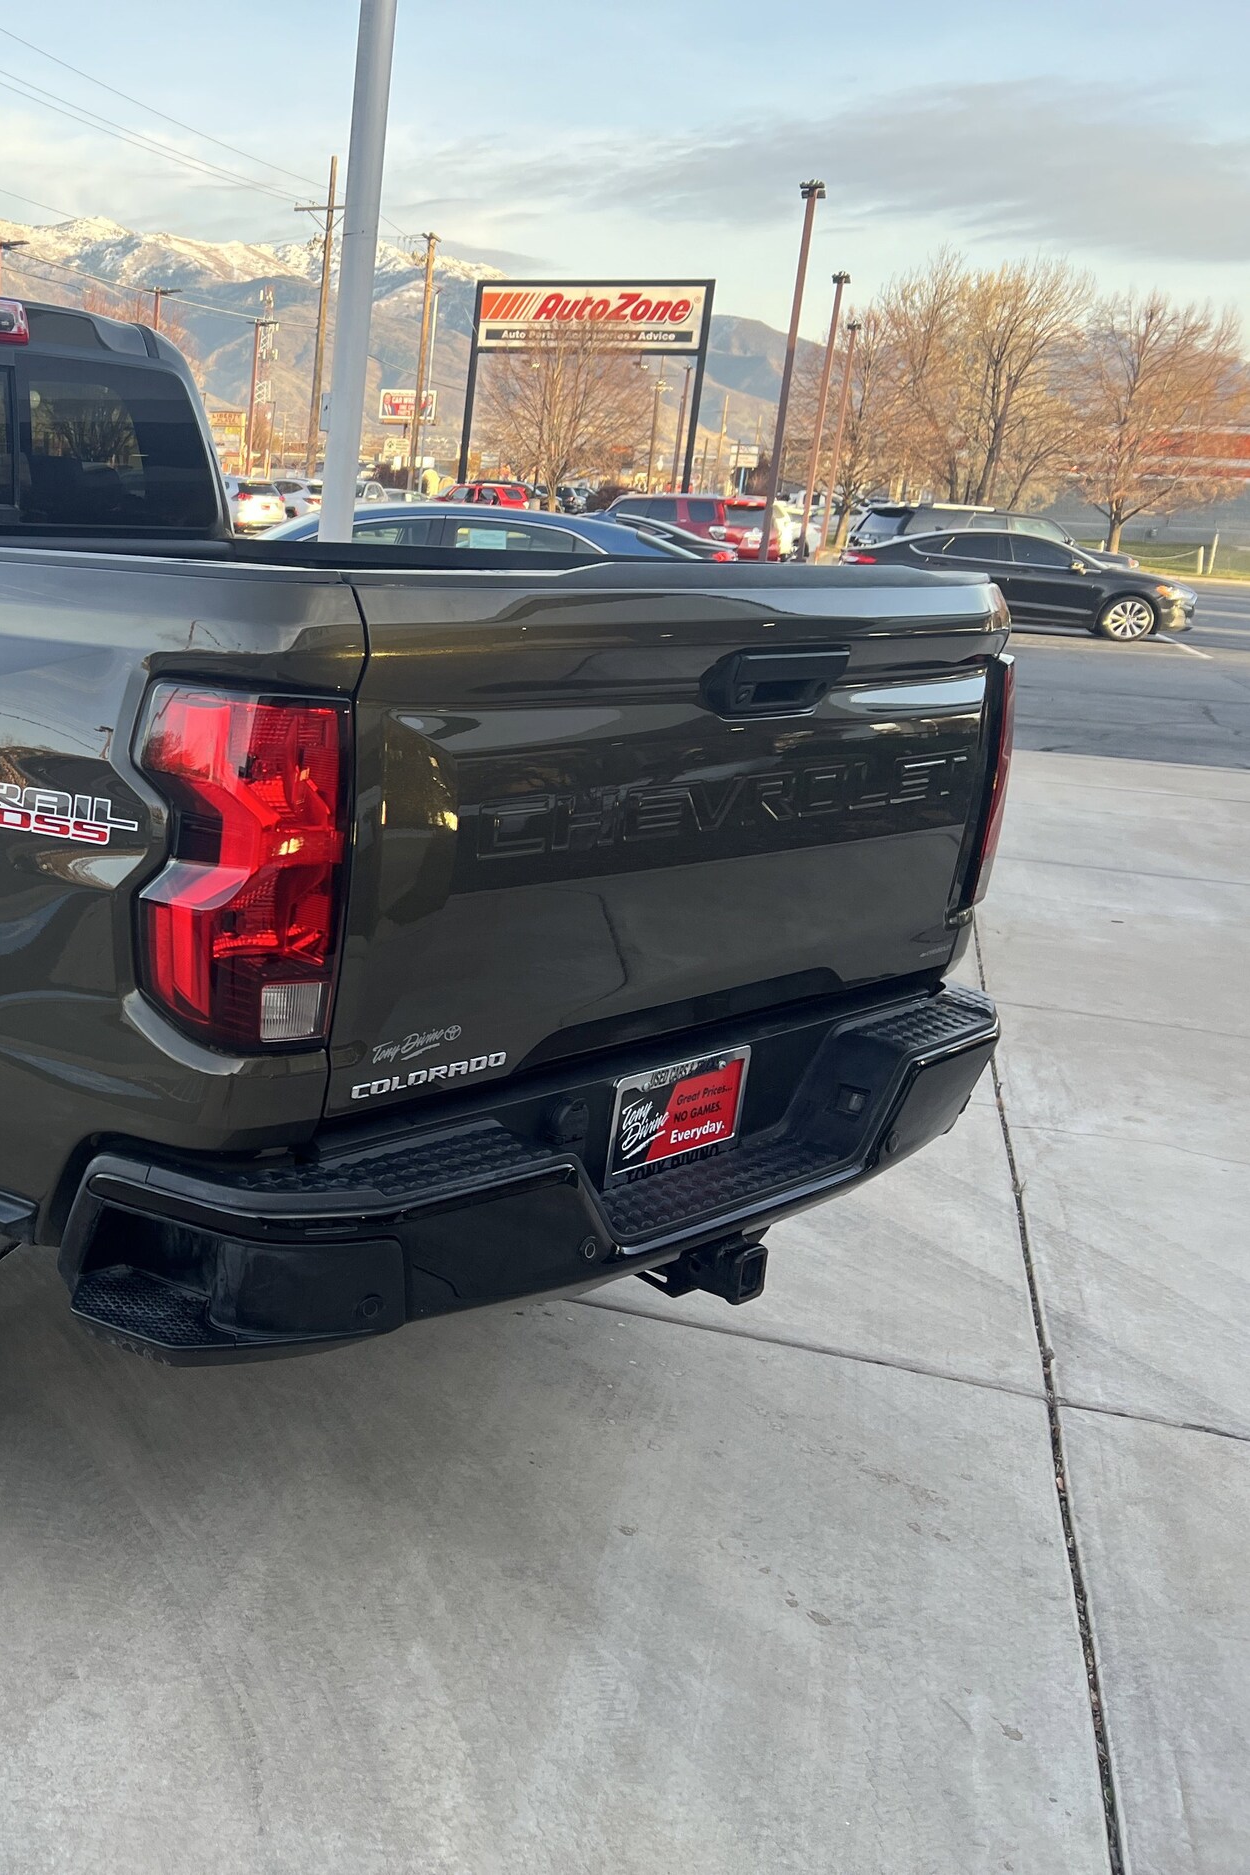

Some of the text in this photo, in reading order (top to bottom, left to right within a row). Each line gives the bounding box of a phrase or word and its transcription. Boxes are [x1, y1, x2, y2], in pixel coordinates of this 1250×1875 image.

[532, 292, 694, 325] AutoZone
[501, 330, 526, 340] Auto
[638, 331, 676, 341] Advice
[477, 747, 968, 860] CHEVROLET
[372, 1028, 445, 1065] Tony Divino
[351, 1051, 507, 1099] COLORADO
[622, 1097, 654, 1130] Tony
[673, 1101, 723, 1124] NO GAMES.
[676, 1093, 701, 1106] Great
[618, 1111, 670, 1151] Divino
[670, 1120, 725, 1144] Everyday.
